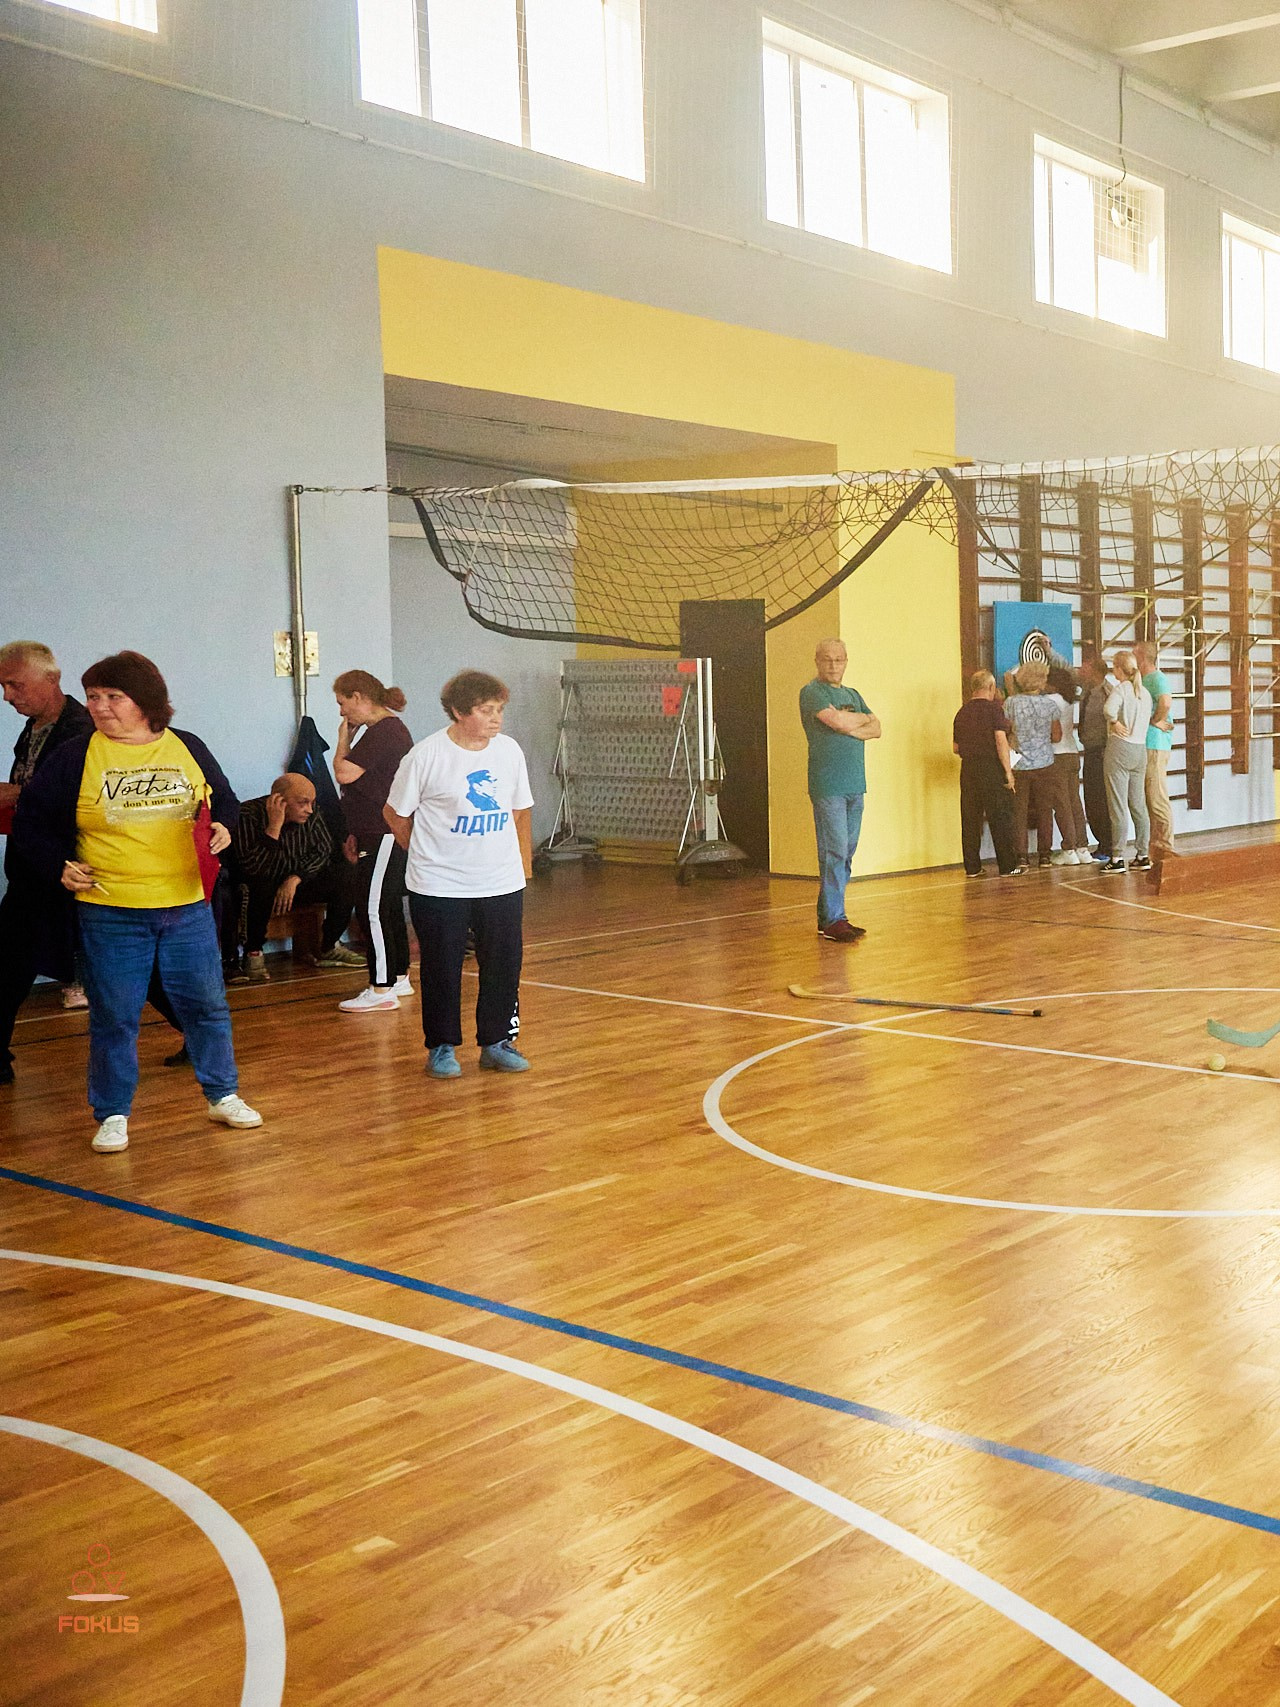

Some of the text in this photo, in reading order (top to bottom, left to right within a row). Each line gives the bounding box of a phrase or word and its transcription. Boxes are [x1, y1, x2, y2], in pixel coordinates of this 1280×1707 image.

[96, 774, 198, 804] Nothing
[123, 800, 148, 808] don't
[450, 812, 509, 837] ЛДПР
